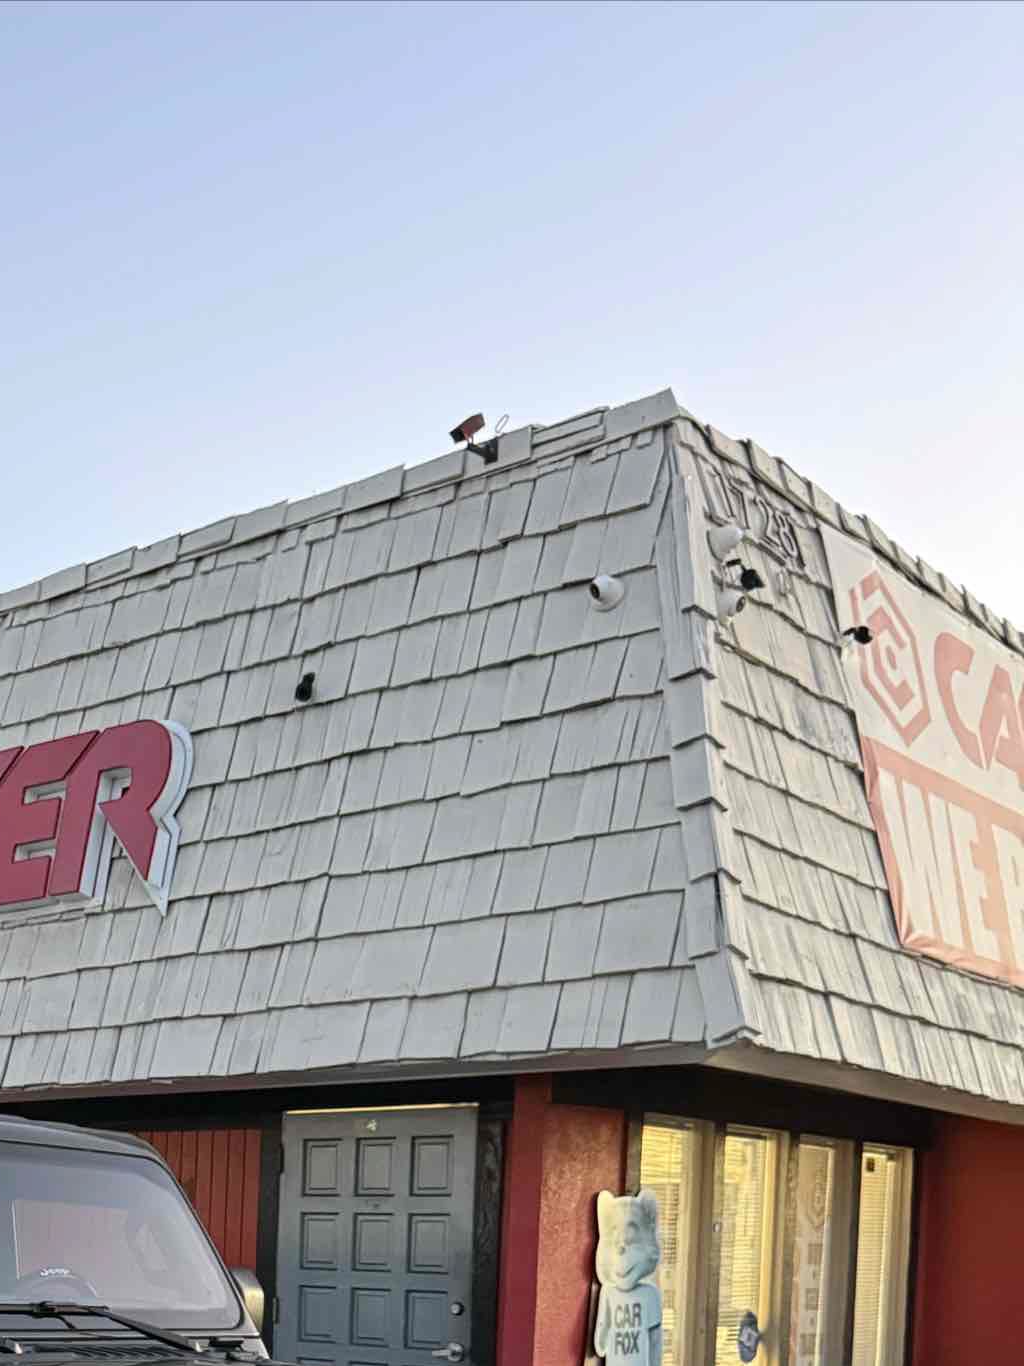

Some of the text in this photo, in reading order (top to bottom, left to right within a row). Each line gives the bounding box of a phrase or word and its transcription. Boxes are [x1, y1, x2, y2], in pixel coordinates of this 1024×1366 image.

[933, 629, 1024, 800] CA
[614, 1303, 642, 1329] CAR
[614, 1331, 641, 1356] FOX
